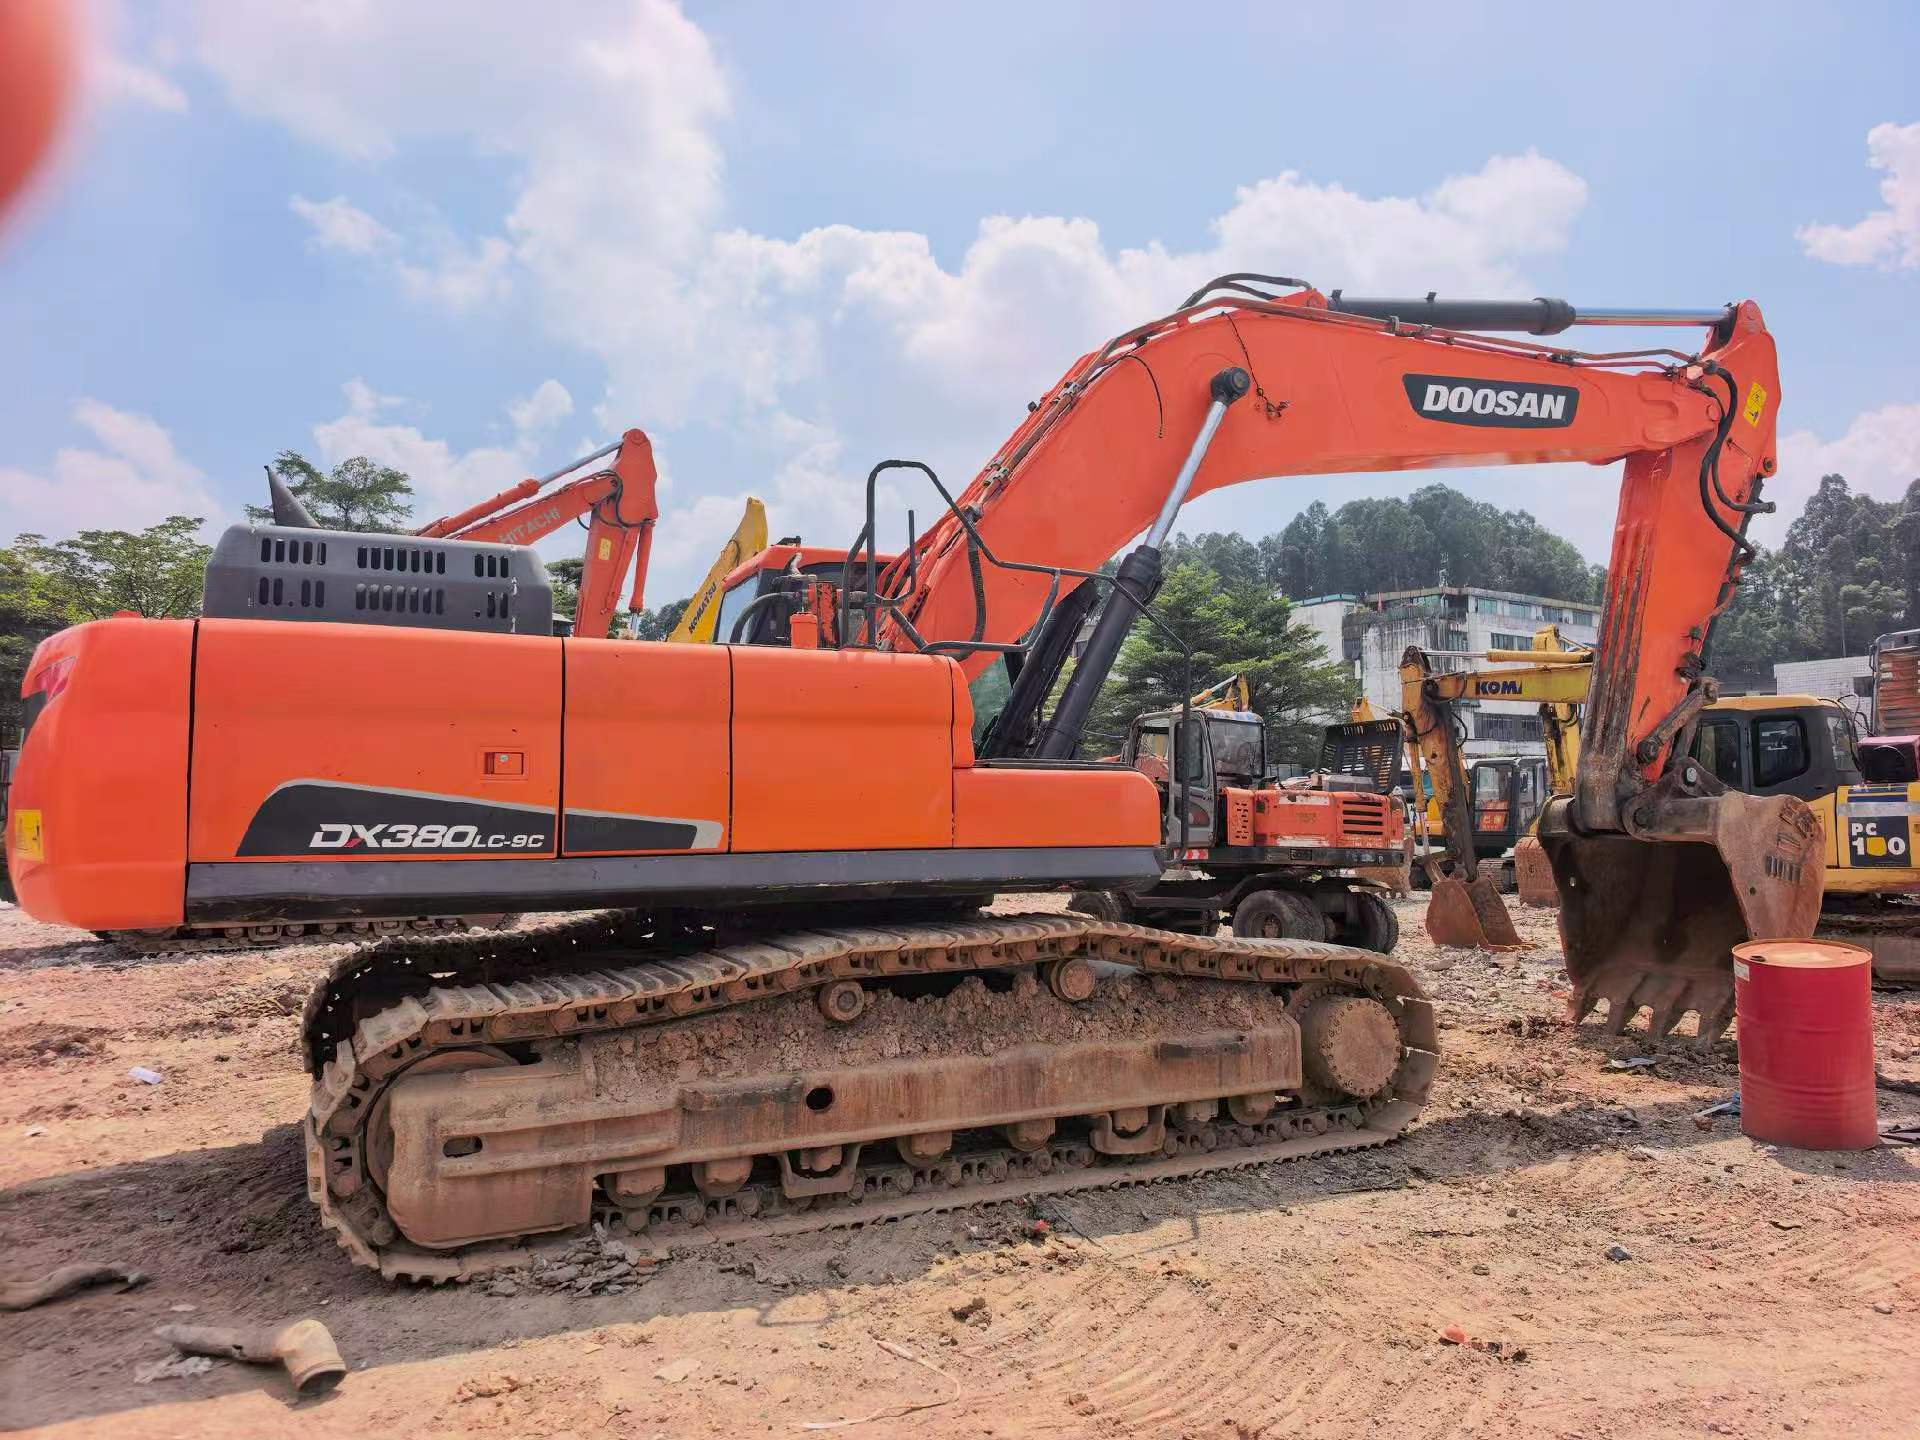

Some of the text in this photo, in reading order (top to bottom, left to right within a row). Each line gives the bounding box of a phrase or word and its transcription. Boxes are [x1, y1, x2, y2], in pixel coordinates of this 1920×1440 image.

[1423, 384, 1566, 420] DOOSAN
[498, 507, 561, 543] HITACHI
[1851, 822, 1878, 836] PC
